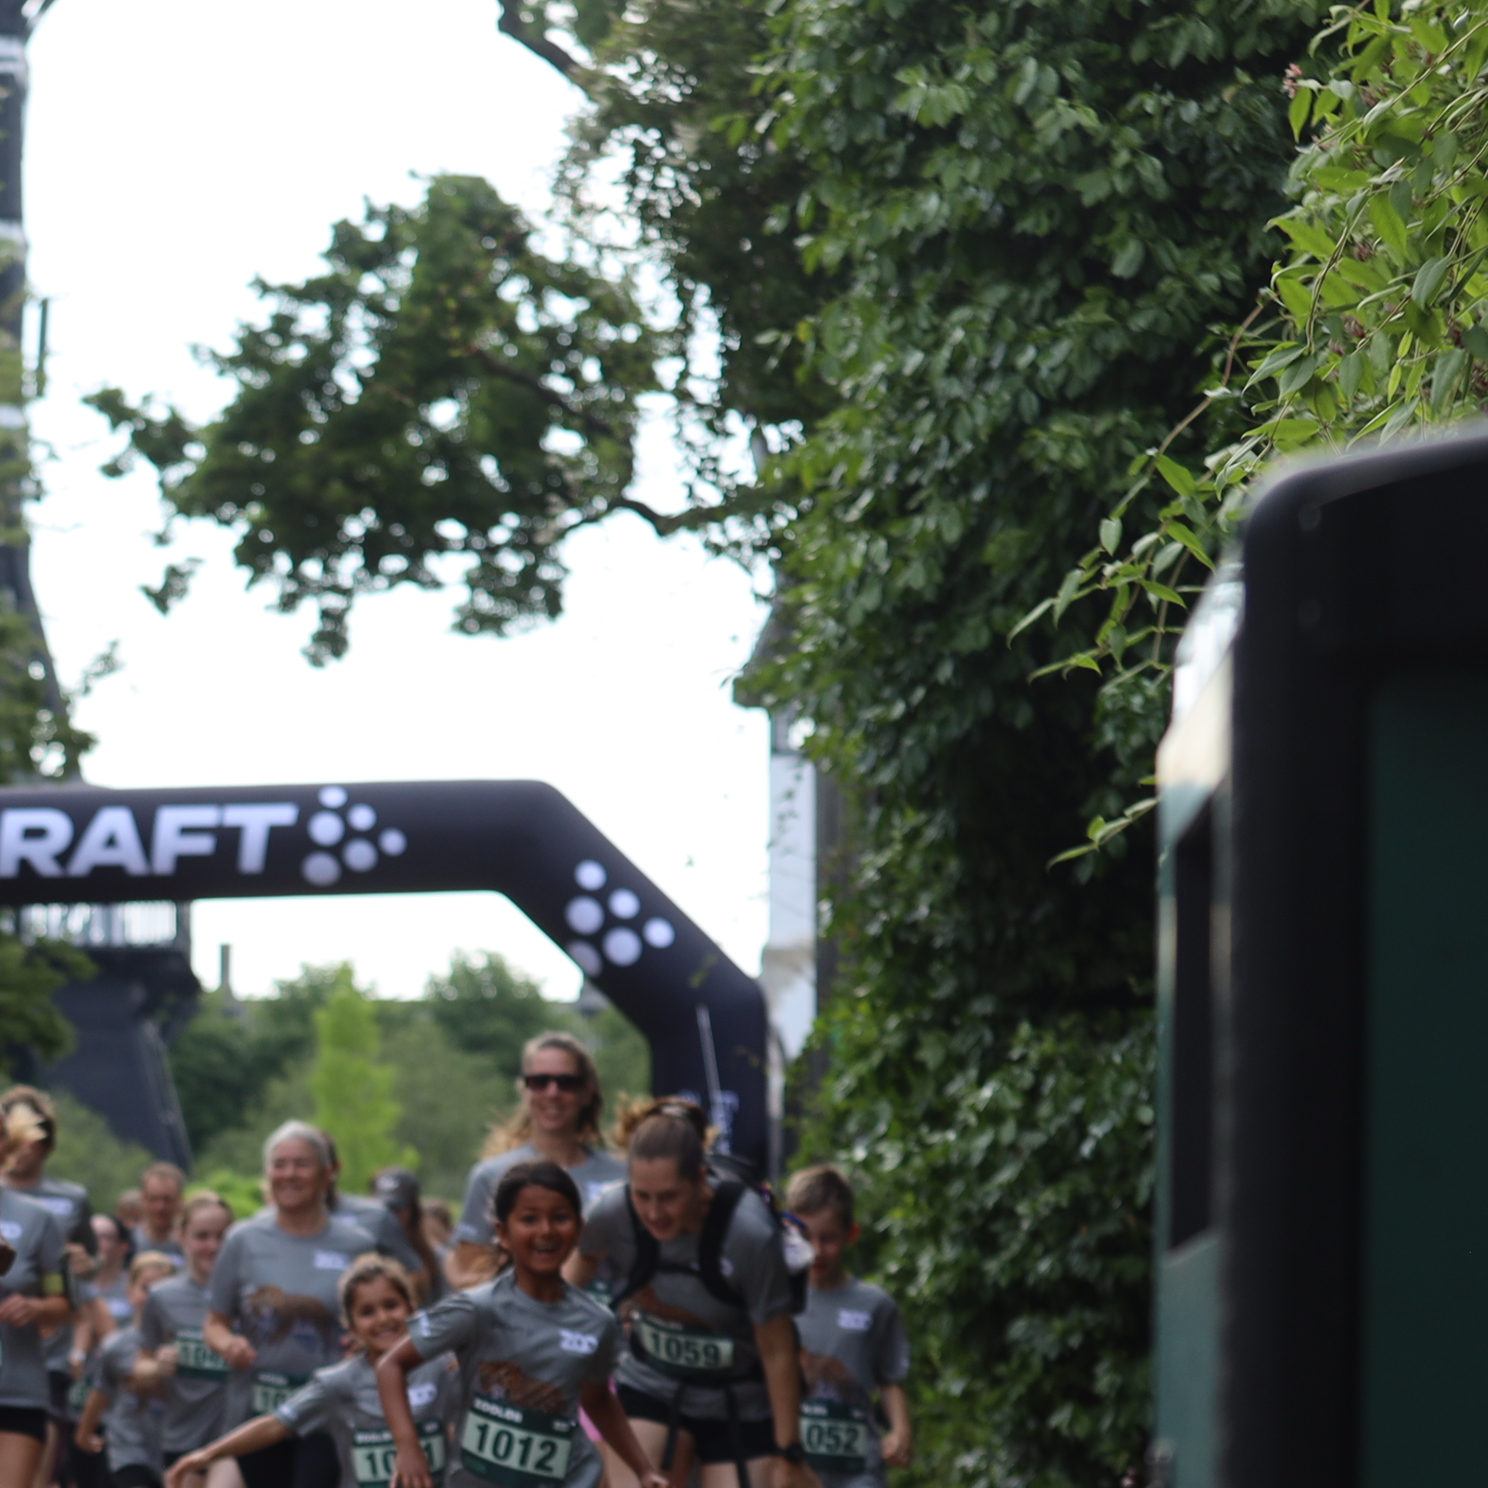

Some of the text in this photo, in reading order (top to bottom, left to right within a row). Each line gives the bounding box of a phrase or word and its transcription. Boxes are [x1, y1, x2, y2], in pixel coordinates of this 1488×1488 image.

[650, 1333, 720, 1367] 1059
[477, 1423, 554, 1473] 1012
[806, 1425, 860, 1451] 052
